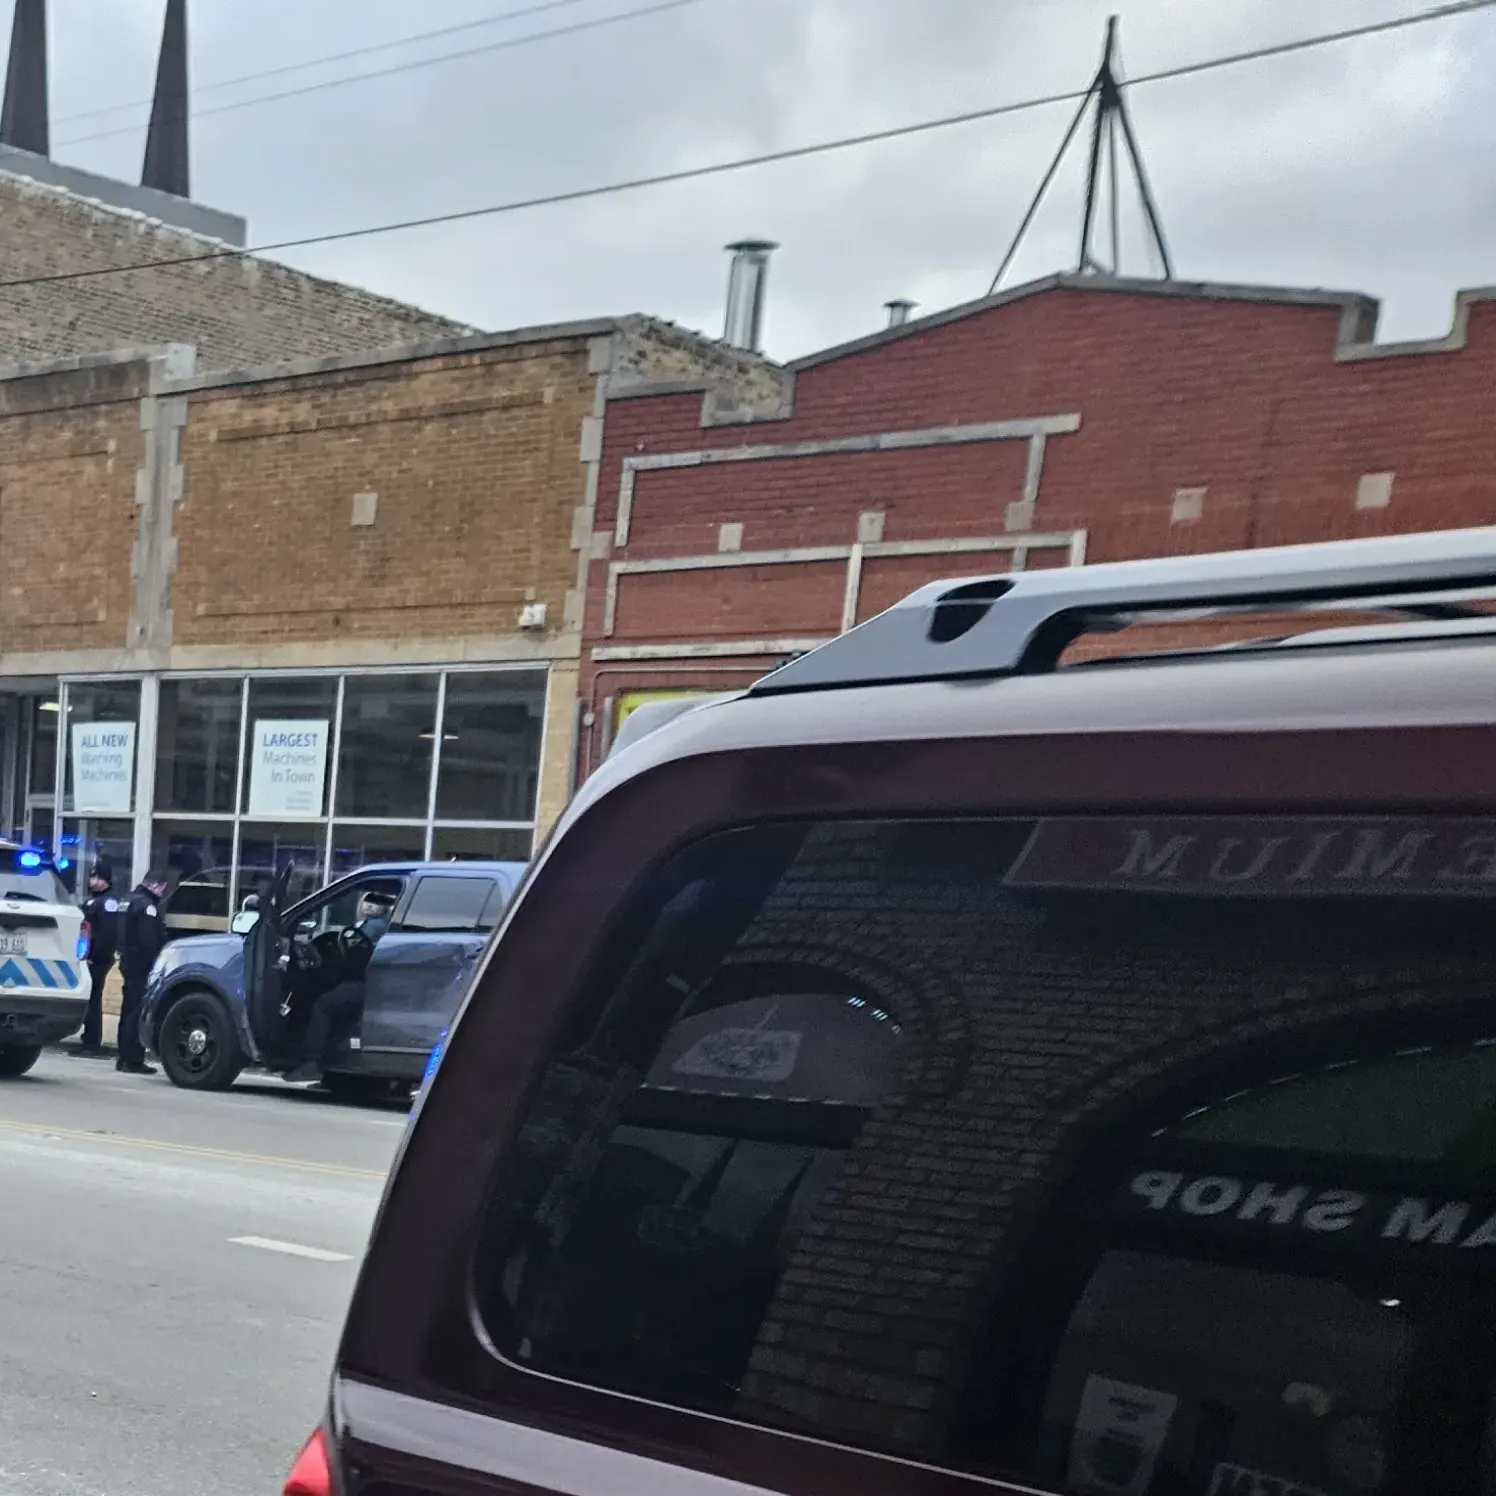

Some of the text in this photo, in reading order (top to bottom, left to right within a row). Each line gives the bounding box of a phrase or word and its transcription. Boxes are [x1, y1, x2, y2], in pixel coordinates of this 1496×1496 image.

[81, 734, 128, 747] ALL NEW
[263, 733, 318, 747] LARGEST
[264, 751, 316, 765] Machines
[285, 769, 315, 783] Town
